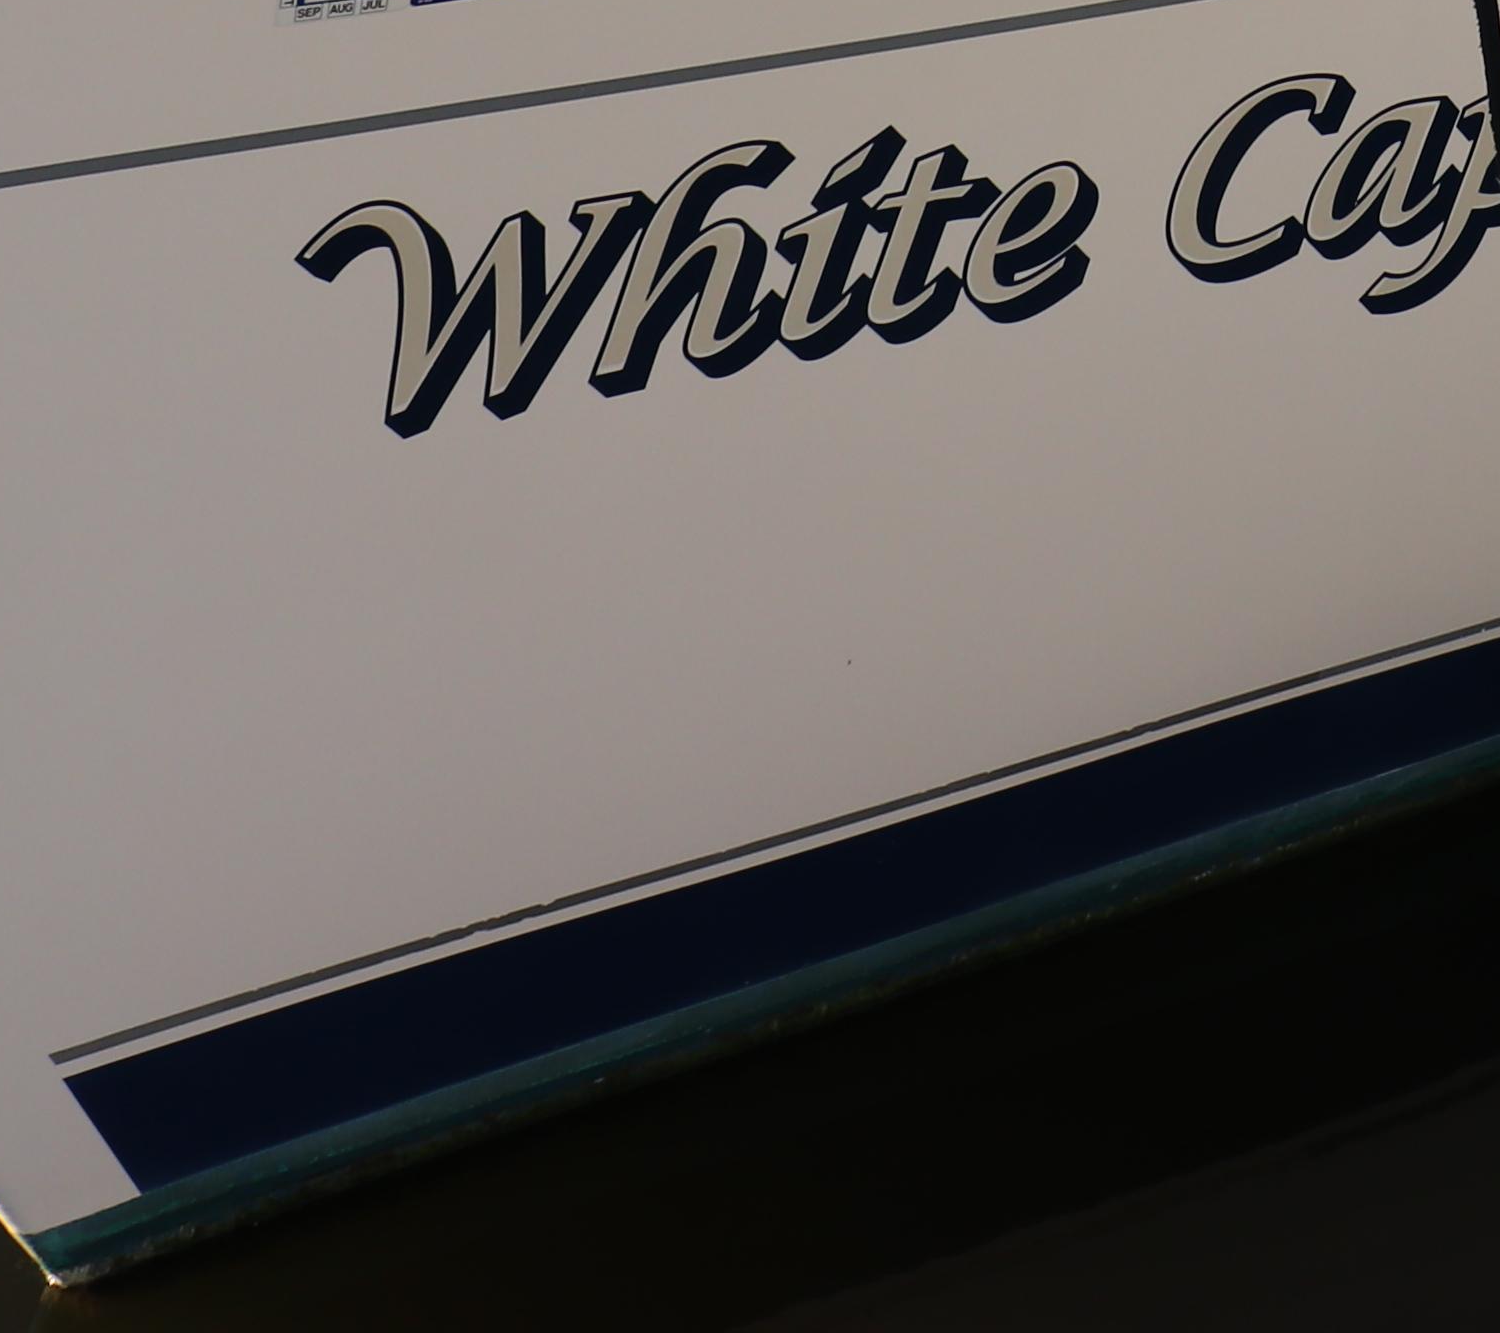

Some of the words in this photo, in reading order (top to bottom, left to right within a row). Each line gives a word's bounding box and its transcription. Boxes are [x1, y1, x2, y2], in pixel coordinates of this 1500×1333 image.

[297, 7, 321, 19] SEP
[329, 3, 353, 14] AUG
[362, 0, 386, 10] JUL
[294, 125, 1100, 438] White
